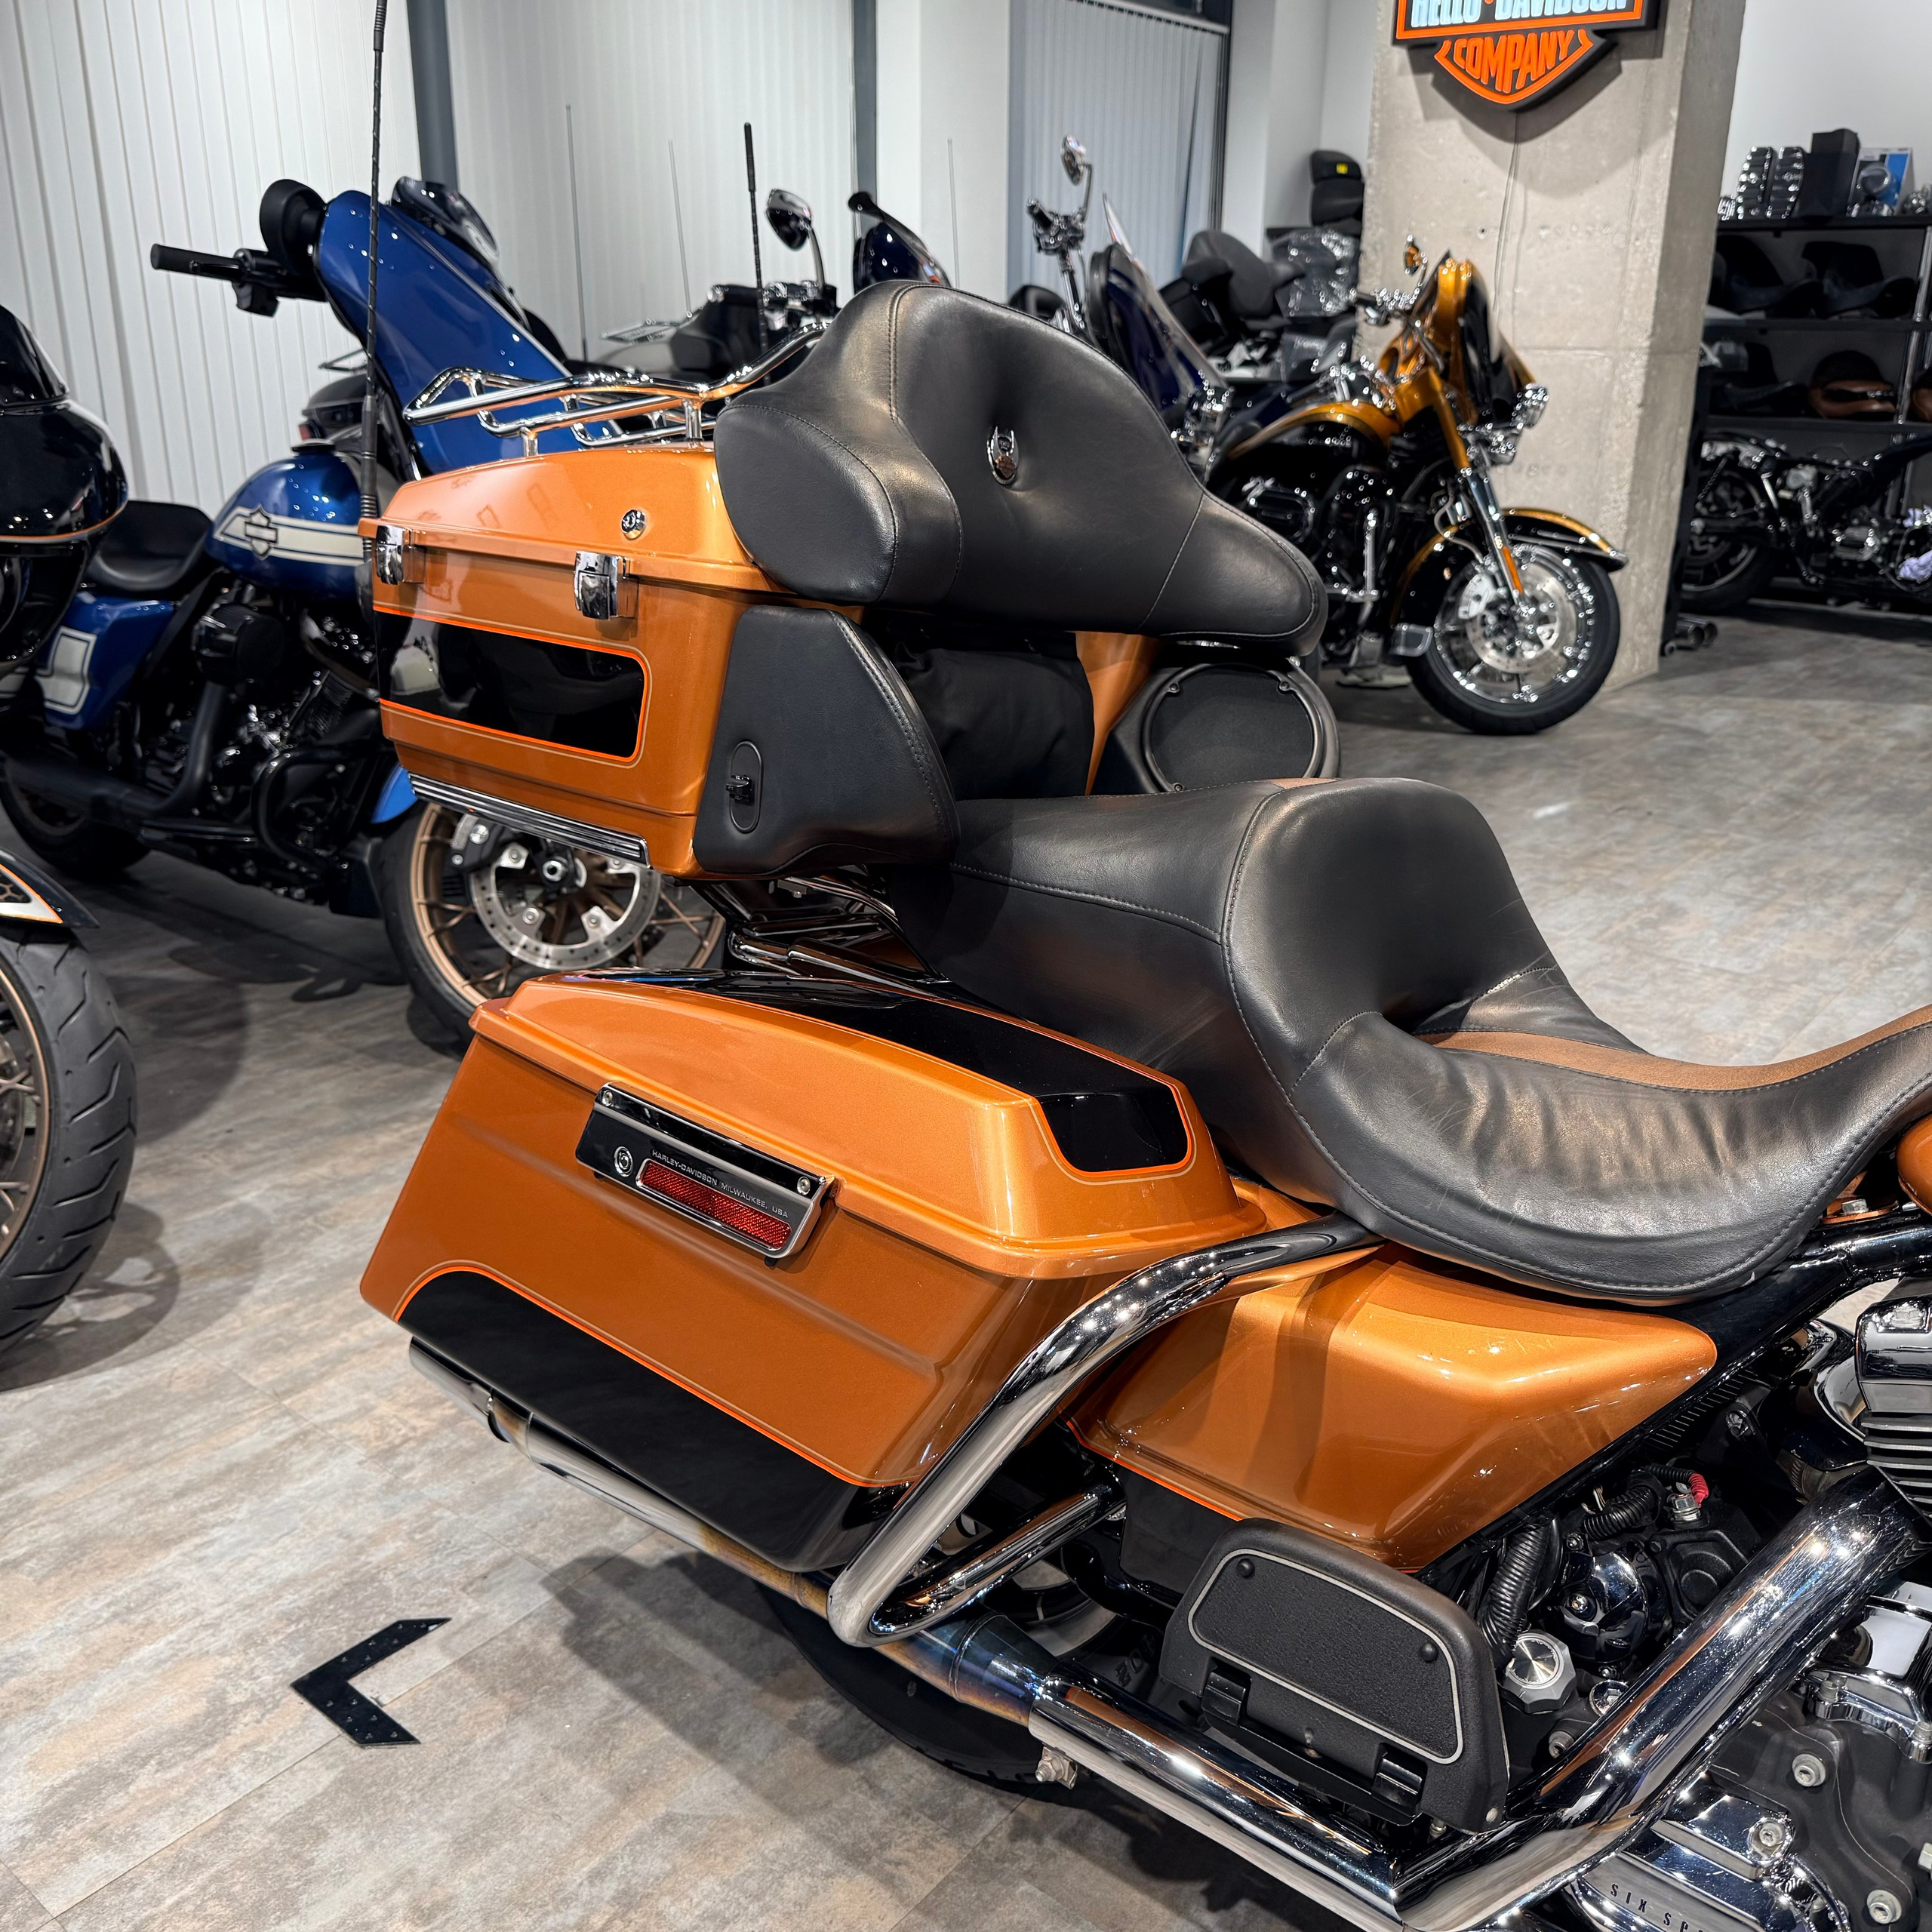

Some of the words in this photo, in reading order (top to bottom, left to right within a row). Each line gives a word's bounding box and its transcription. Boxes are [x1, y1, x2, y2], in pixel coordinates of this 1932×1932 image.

[1453, 29, 1575, 93] COMPANY
[651, 1149, 718, 1186] HARLEY-DAVIDSON
[721, 1182, 768, 1209] MILWAUKEE,
[772, 1205, 789, 1218] USA
[1611, 1883, 1647, 1913] SIX
[1663, 1912, 1703, 1932] SP
